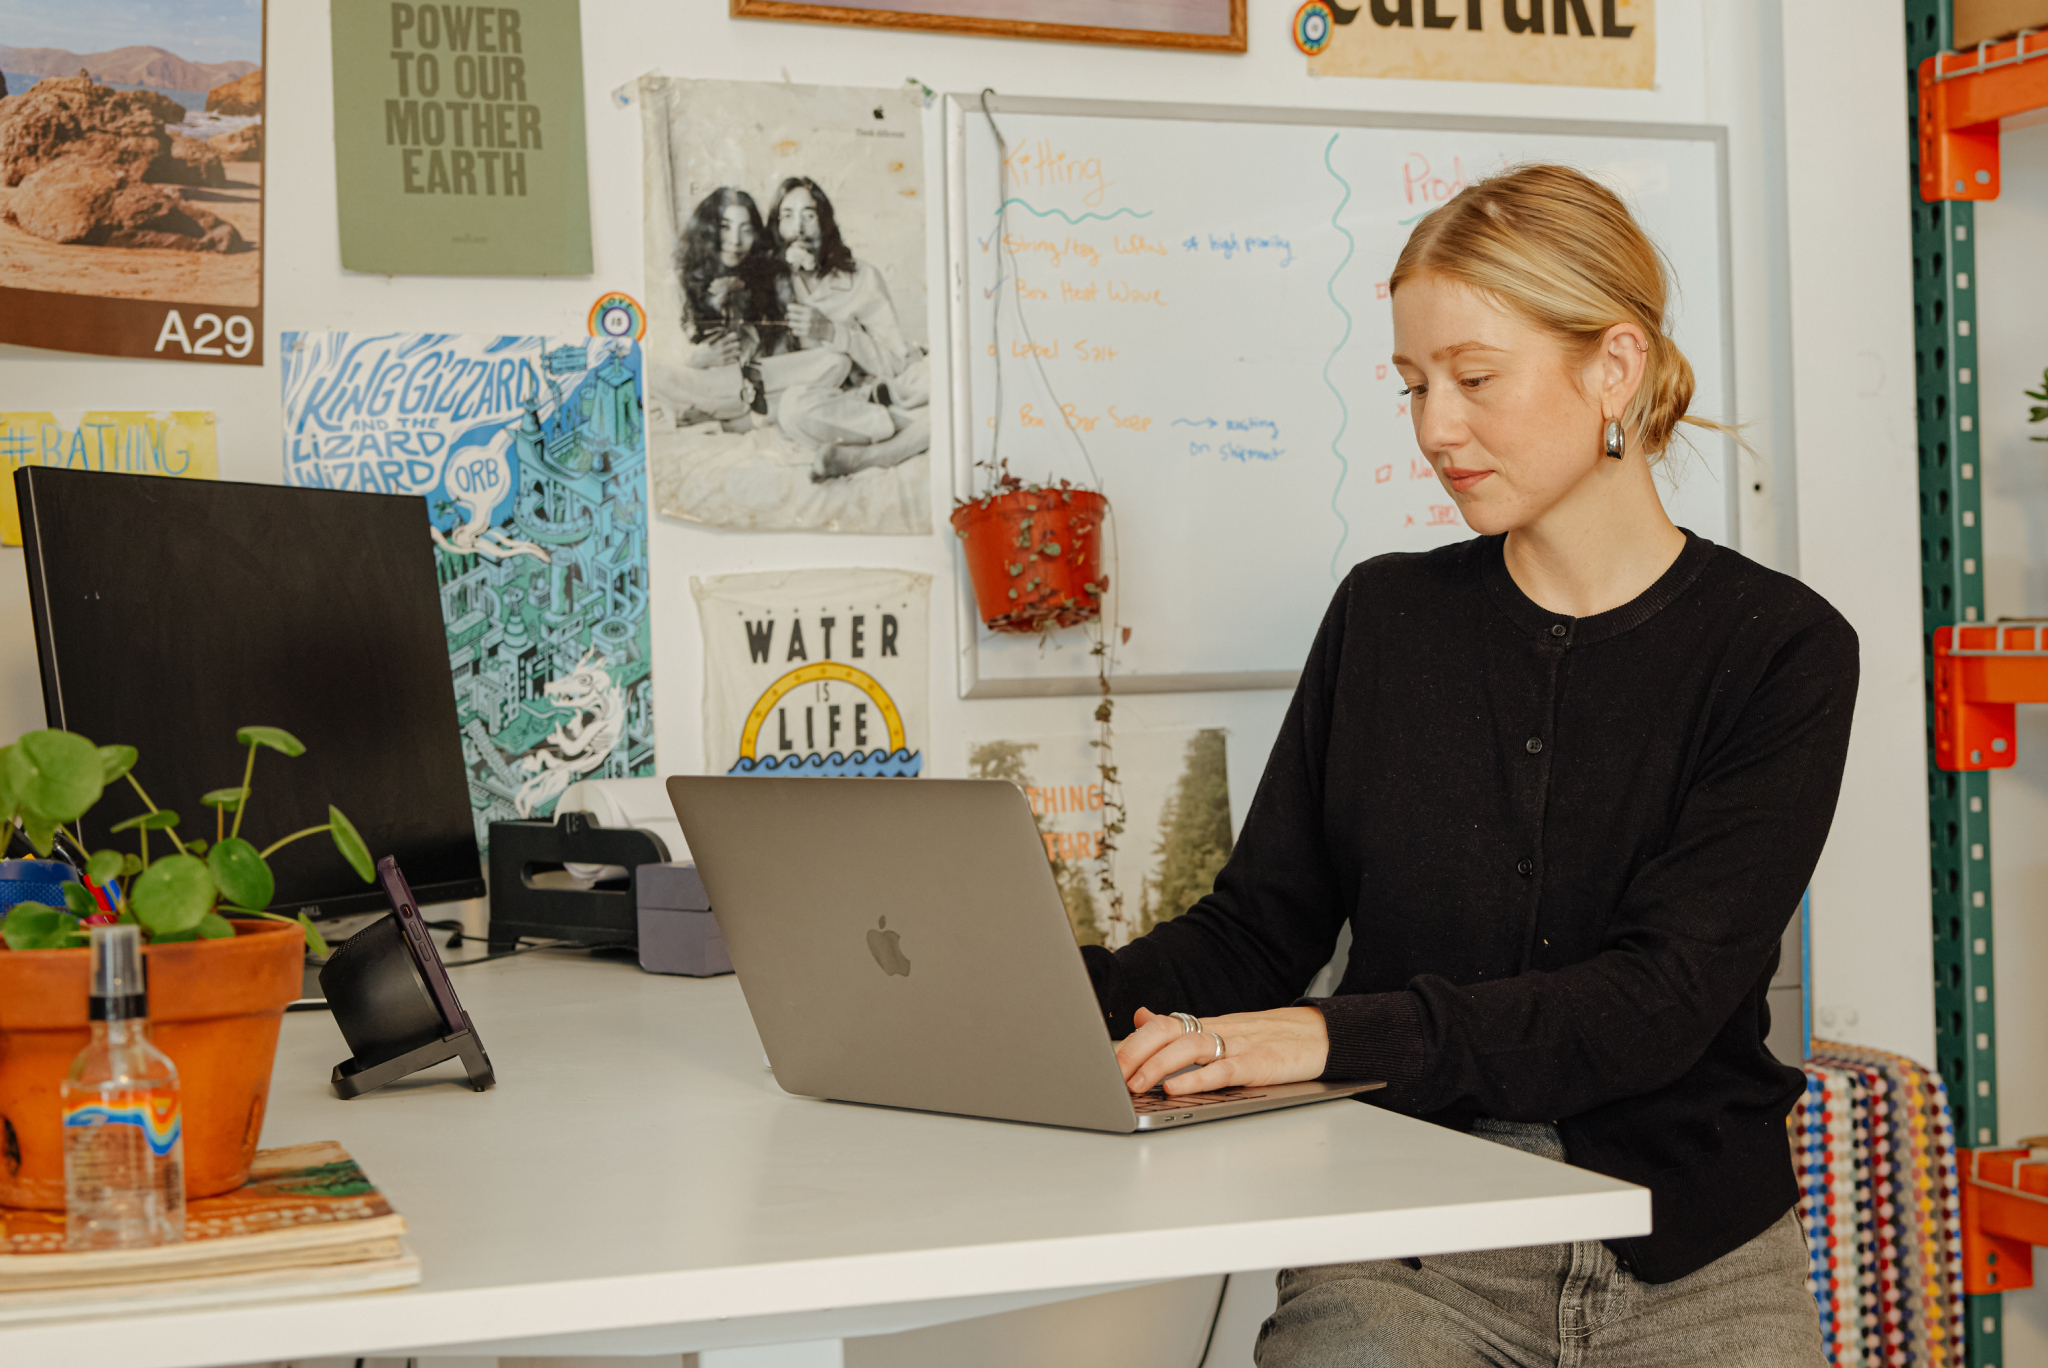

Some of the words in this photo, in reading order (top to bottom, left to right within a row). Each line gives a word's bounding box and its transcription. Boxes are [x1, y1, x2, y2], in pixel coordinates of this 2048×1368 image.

[391, 2, 522, 54] POWER
[390, 51, 440, 98] TO
[454, 54, 527, 102] OUR
[384, 99, 542, 150] MOTHER
[402, 148, 527, 196] EARTH
[1001, 138, 1115, 208] Kitting
[1208, 233, 1241, 260] high
[1015, 278, 1049, 299] Box
[154, 309, 255, 359] A29
[0, 422, 190, 475] #BATHING
[350, 419, 390, 432] AND
[396, 418, 440, 430] THE
[455, 458, 500, 494] ORB
[744, 615, 899, 664] WATER
[815, 683, 831, 703] IS
[778, 704, 868, 751] LIFE
